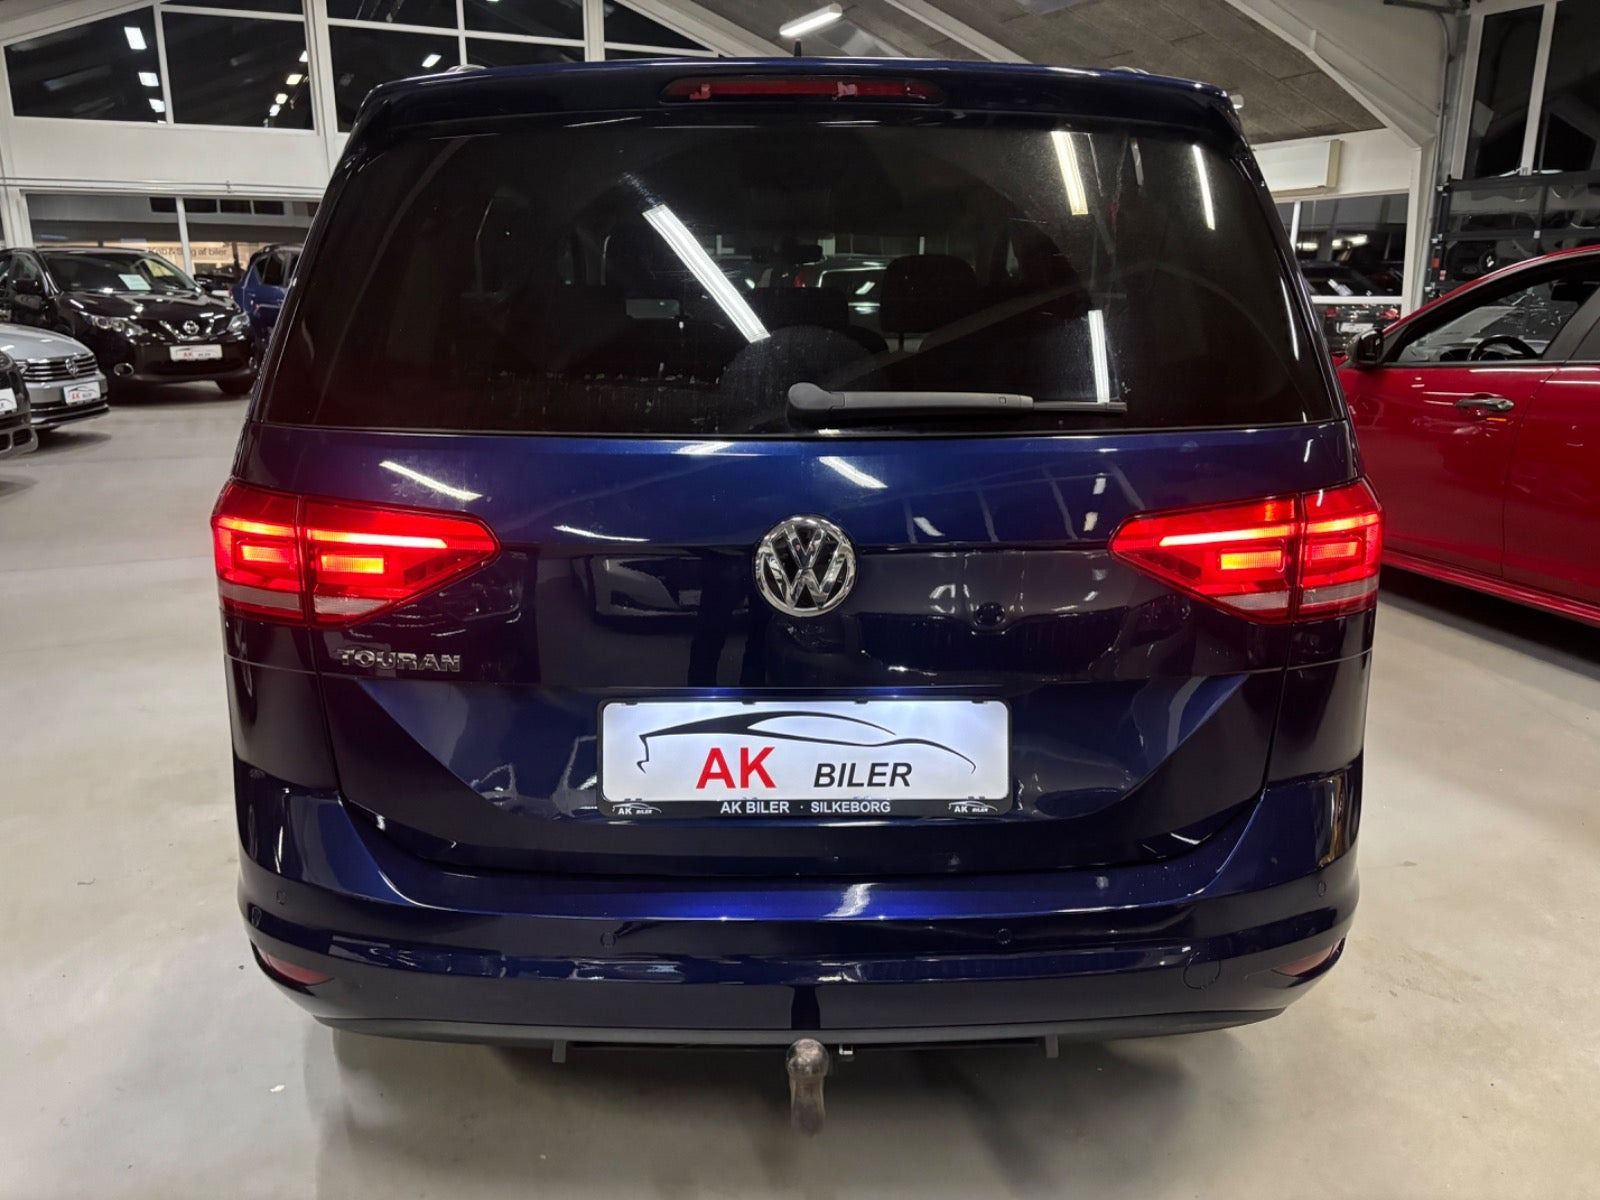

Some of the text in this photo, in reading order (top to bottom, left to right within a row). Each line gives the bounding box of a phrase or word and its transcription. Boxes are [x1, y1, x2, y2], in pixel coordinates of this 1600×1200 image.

[337, 649, 460, 672] TOURAN
[695, 746, 913, 790] AK BILER
[617, 807, 633, 816] AK
[720, 801, 892, 814] AK BILER SILKEBORG
[953, 805, 969, 813] AK
